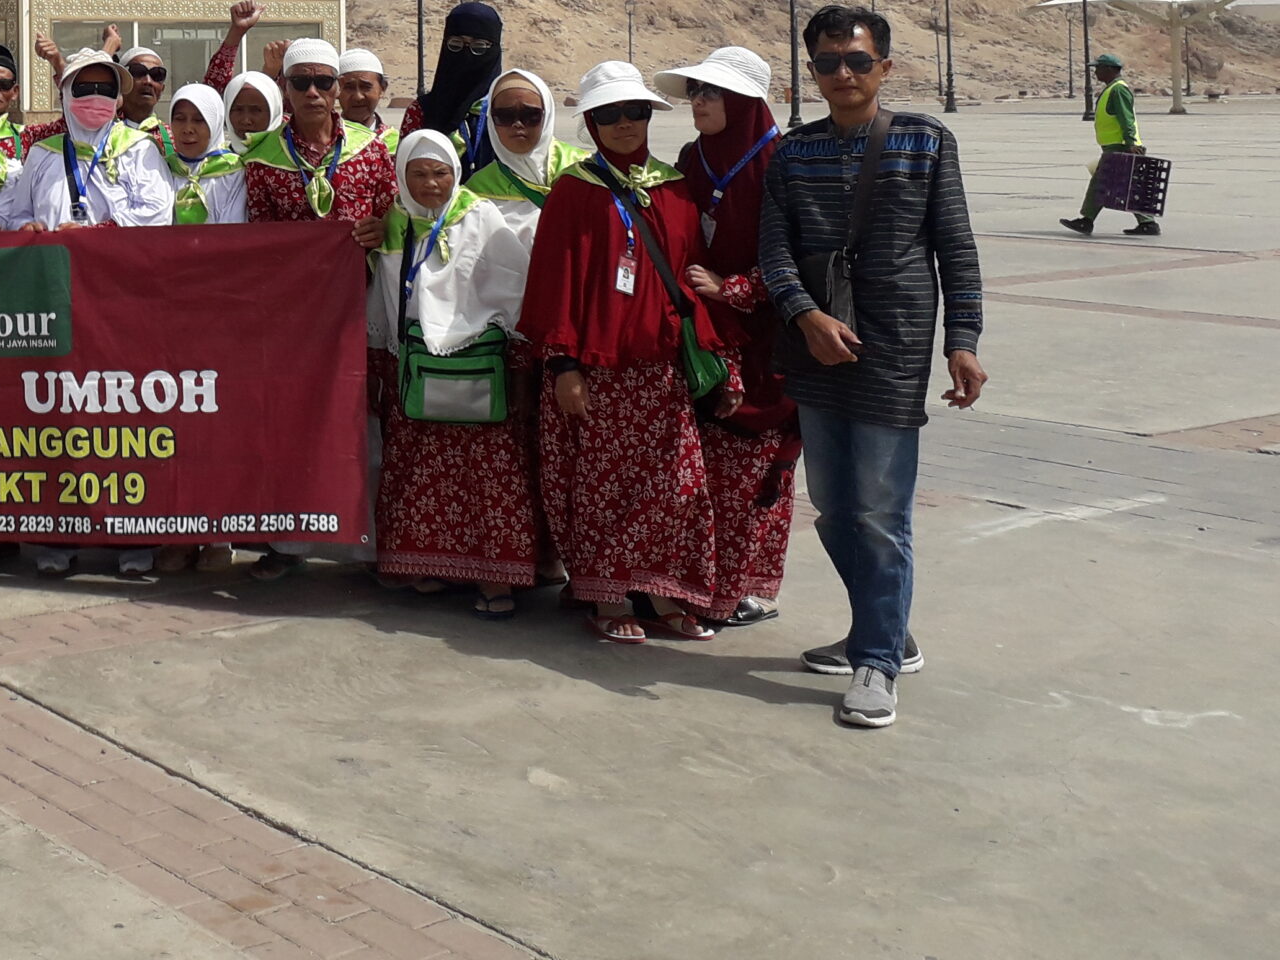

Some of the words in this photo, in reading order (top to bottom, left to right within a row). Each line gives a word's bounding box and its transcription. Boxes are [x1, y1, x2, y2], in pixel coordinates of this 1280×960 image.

[6, 339, 28, 349] JAYA
[29, 339, 57, 348] INSANI
[21, 369, 220, 415] UMROH
[58, 471, 146, 504] 2019
[19, 515, 54, 532] 2829
[58, 516, 92, 533] 3788
[104, 516, 209, 534] TEMANGGUNG
[221, 514, 256, 533] 0852
[260, 513, 295, 532] 2506
[299, 513, 339, 532] 7588
